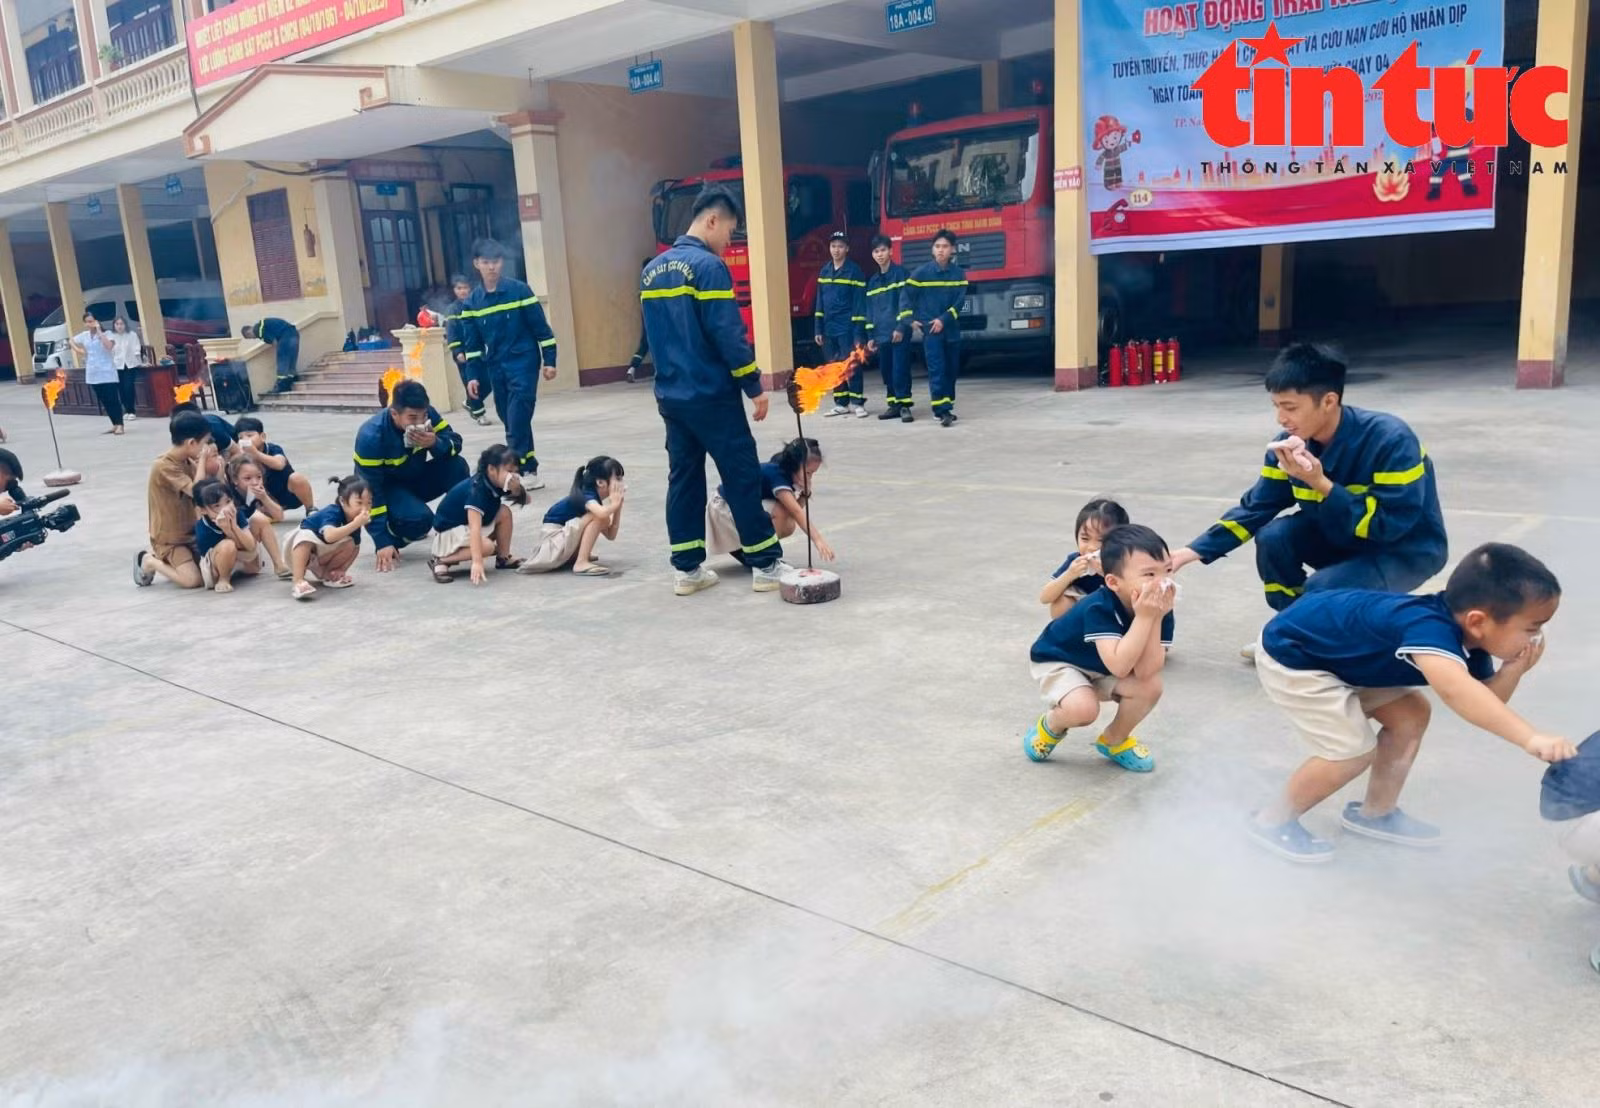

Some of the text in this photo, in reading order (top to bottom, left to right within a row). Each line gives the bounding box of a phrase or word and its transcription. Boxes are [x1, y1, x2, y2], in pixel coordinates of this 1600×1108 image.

[1144, 3, 1199, 38] HOẠT
[1345, 25, 1368, 49] NẠN
[1391, 11, 1407, 38] HỘ
[1411, 6, 1445, 31] NHÂN
[1449, 3, 1467, 28] DỊP
[1112, 59, 1141, 79] TUYÊN
[1132, 192, 1149, 204] 114
